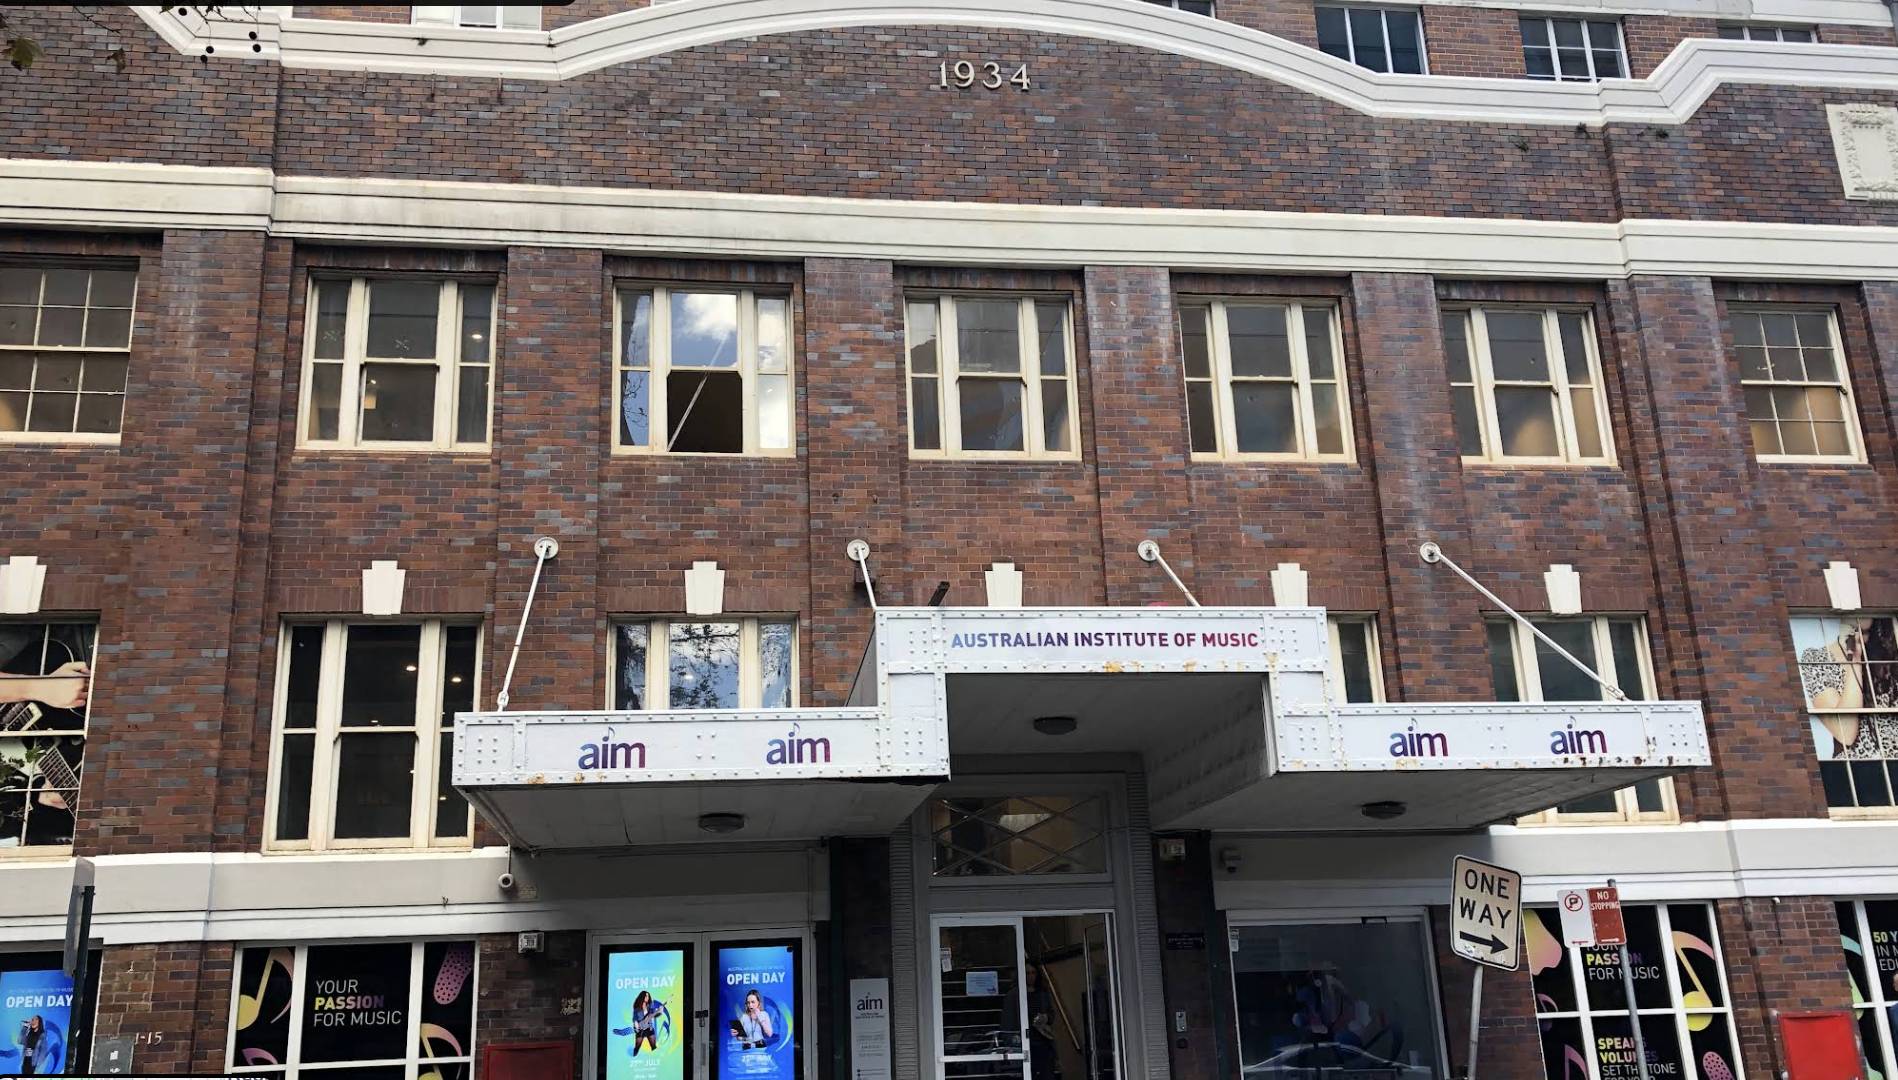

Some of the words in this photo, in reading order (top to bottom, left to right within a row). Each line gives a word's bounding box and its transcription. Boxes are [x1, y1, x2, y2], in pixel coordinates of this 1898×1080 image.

[939, 60, 1031, 91] 1934
[951, 632, 1069, 649] AUSTRALIAN
[1074, 632, 1169, 647] INSTITUTE
[1174, 632, 1196, 647] OF
[1202, 632, 1259, 647] MUSIC
[1389, 725, 1449, 757] aim
[1550, 723, 1608, 755] aim
[578, 735, 646, 770] aim
[766, 730, 831, 765] aim
[1464, 868, 1510, 900] ONE
[1596, 891, 1609, 900] NO
[1459, 896, 1513, 929] WAY
[1590, 902, 1620, 911] STOPPING
[1872, 931, 1888, 943] 50
[1876, 944, 1890, 957] IN
[726, 972, 760, 986] OPEN
[762, 971, 786, 984] DAY
[1588, 967, 1615, 981] FOR
[315, 979, 359, 995] YOUR
[616, 976, 649, 990] OPEN
[652, 975, 676, 988] DAY
[6, 994, 44, 1009] OPEN
[46, 994, 74, 1007] DAY
[314, 994, 385, 1011] PASSION
[856, 995, 884, 1011] aim
[313, 1012, 346, 1028] FOR
[350, 1010, 402, 1026] MUSIC
[1602, 1064, 1623, 1077] SET
[1647, 1062, 1677, 1075] TONE
